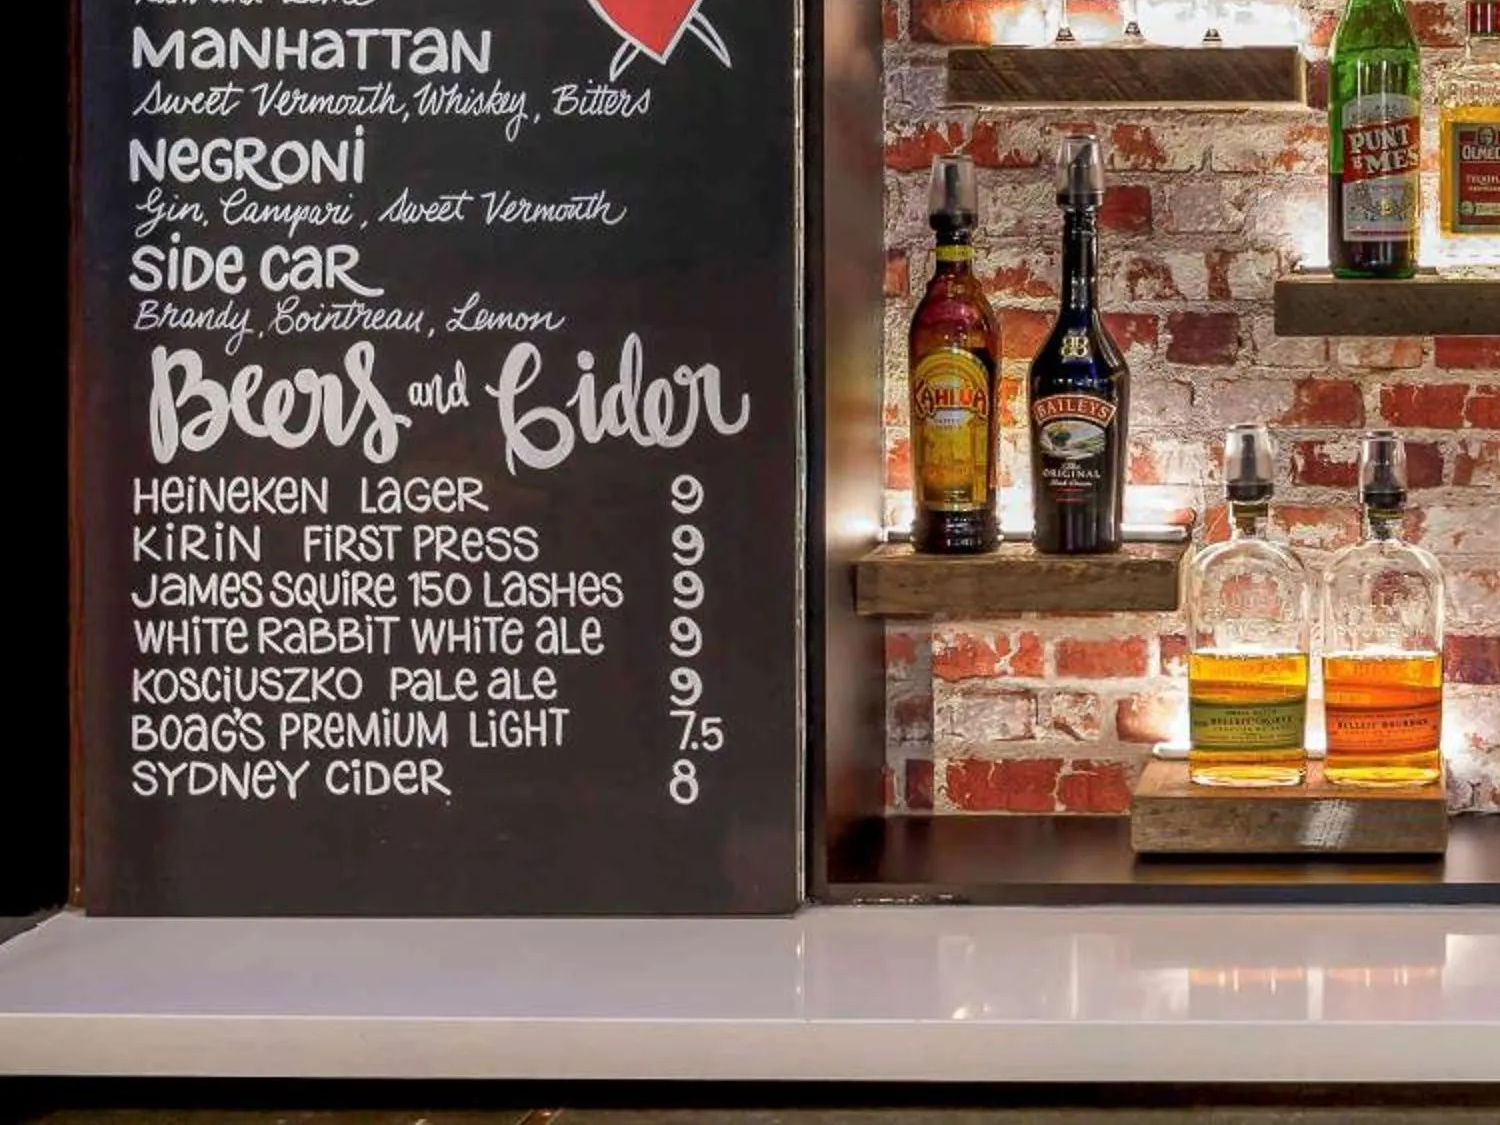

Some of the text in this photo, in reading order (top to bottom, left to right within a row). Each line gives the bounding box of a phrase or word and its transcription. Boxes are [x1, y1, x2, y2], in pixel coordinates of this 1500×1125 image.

[133, 81, 244, 116] Sweet
[552, 79, 650, 117] Bitters
[1349, 125, 1411, 154] PUNT
[1364, 146, 1420, 174] MES
[378, 187, 474, 223] Sweet
[481, 190, 626, 225] Vermouth
[446, 292, 565, 331] Lemon
[150, 333, 750, 475] Beers and Cider
[1036, 399, 1111, 419] BAILEYS
[672, 475, 704, 514] 9
[672, 525, 704, 565] 9
[408, 571, 472, 607] 150
[673, 571, 704, 609] 9
[670, 616, 702, 657] 9
[670, 667, 702, 706] 9
[670, 710, 723, 751] 7.5
[670, 759, 698, 804] 8
